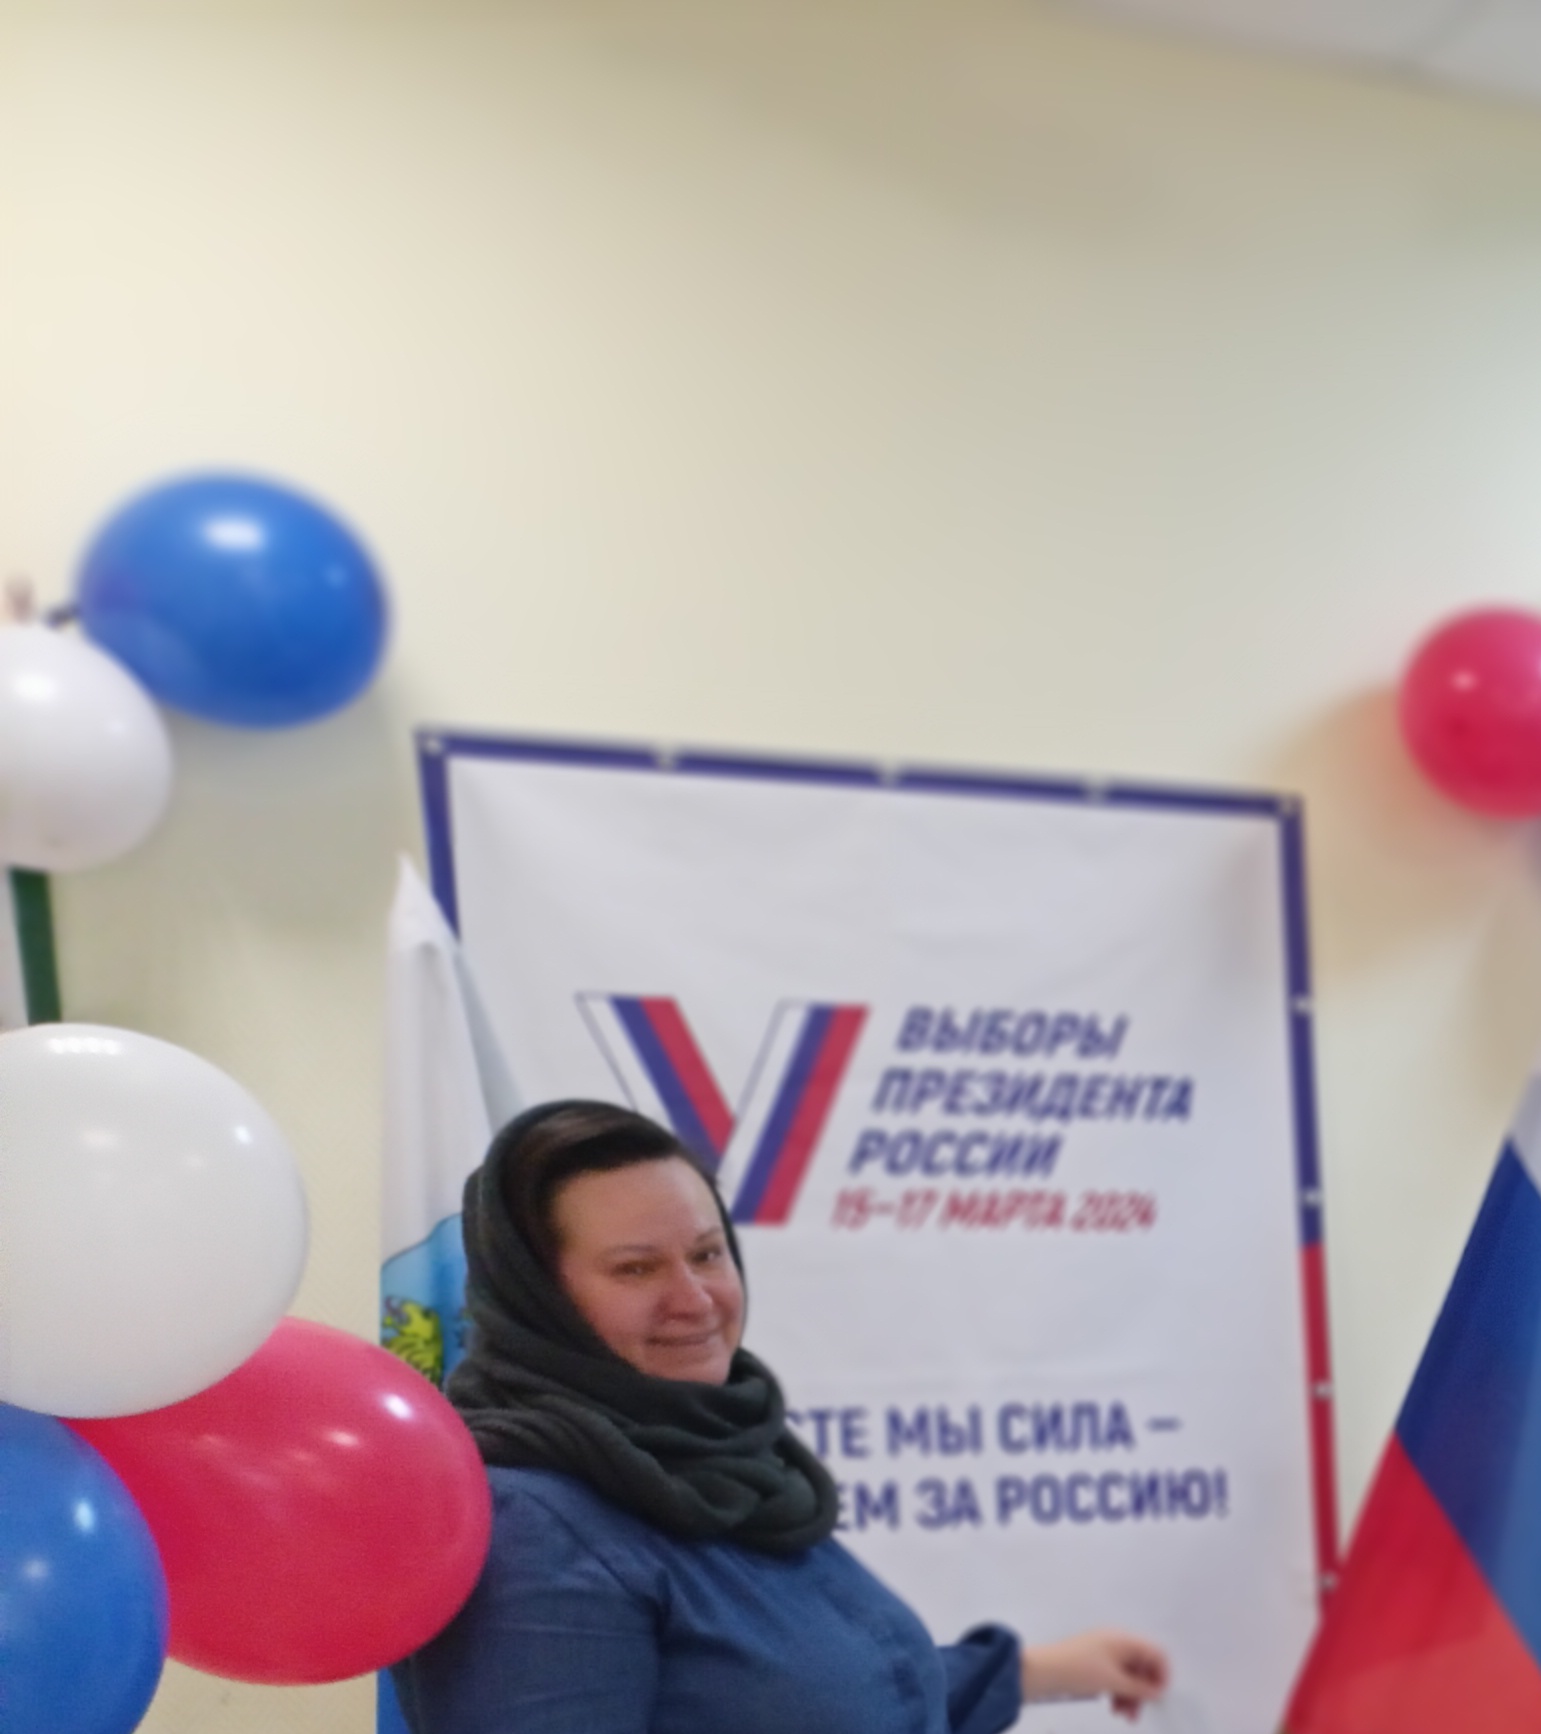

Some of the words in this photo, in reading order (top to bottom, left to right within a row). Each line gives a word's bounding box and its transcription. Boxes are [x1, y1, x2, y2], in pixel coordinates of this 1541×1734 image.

[897, 1005, 1130, 1059] ВЫБОРЫ
[872, 1066, 1195, 1124] ПРЕЗИДЕНТА
[848, 1127, 1063, 1179] РОССИИ
[938, 1188, 1066, 1231] МАРТА
[1069, 1190, 1157, 1232] 2024
[885, 1403, 984, 1458] МЫ
[998, 1399, 1136, 1454] СИЛА
[914, 1475, 983, 1530] ЗА
[996, 1465, 1230, 1527] РОССИЮ!
